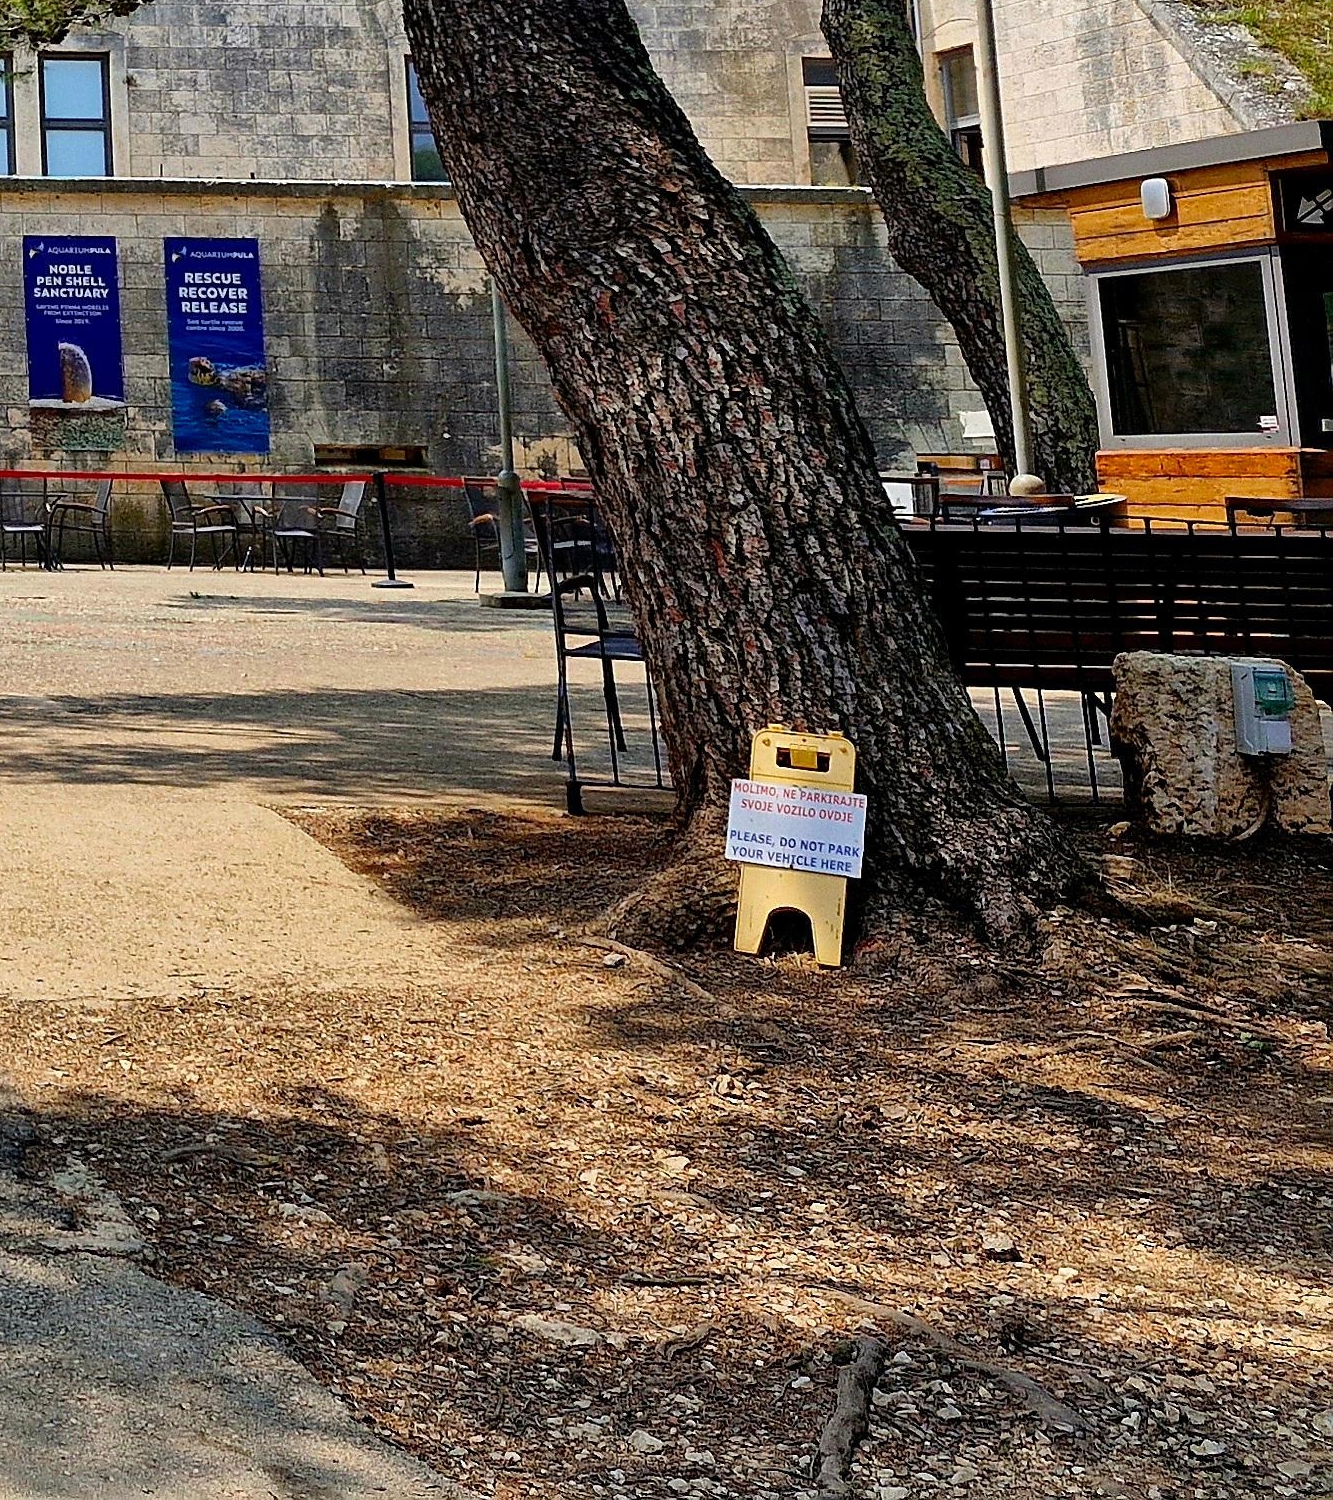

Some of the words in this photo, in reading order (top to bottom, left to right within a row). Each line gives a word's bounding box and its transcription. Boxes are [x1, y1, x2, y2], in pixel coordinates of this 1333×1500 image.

[47, 246, 111, 255] AQUARIUMPULA
[190, 251, 254, 259] AQUARIUMPULA
[49, 264, 93, 275] NOBLE
[36, 276, 62, 286] PEN
[65, 276, 106, 287] SHELL
[184, 272, 242, 285] RESCUE
[33, 287, 109, 299] SANCTUARY
[178, 286, 248, 300] RECOVER
[181, 301, 248, 314] RELEASE
[733, 781, 780, 799] MOLIMO,
[783, 788, 797, 800] NE
[799, 790, 865, 809] PARKIRAJTE
[740, 798, 773, 813] SVOJE
[776, 803, 816, 816] VOZILO
[818, 809, 853, 823] OVDJE
[730, 829, 775, 848] PLEASE,
[779, 836, 797, 849] DO
[800, 839, 825, 853] NOT
[828, 843, 861, 858] PARK
[732, 845, 764, 860] YOUR
[767, 851, 819, 868] VEHICLE
[820, 859, 852, 873] HERE
